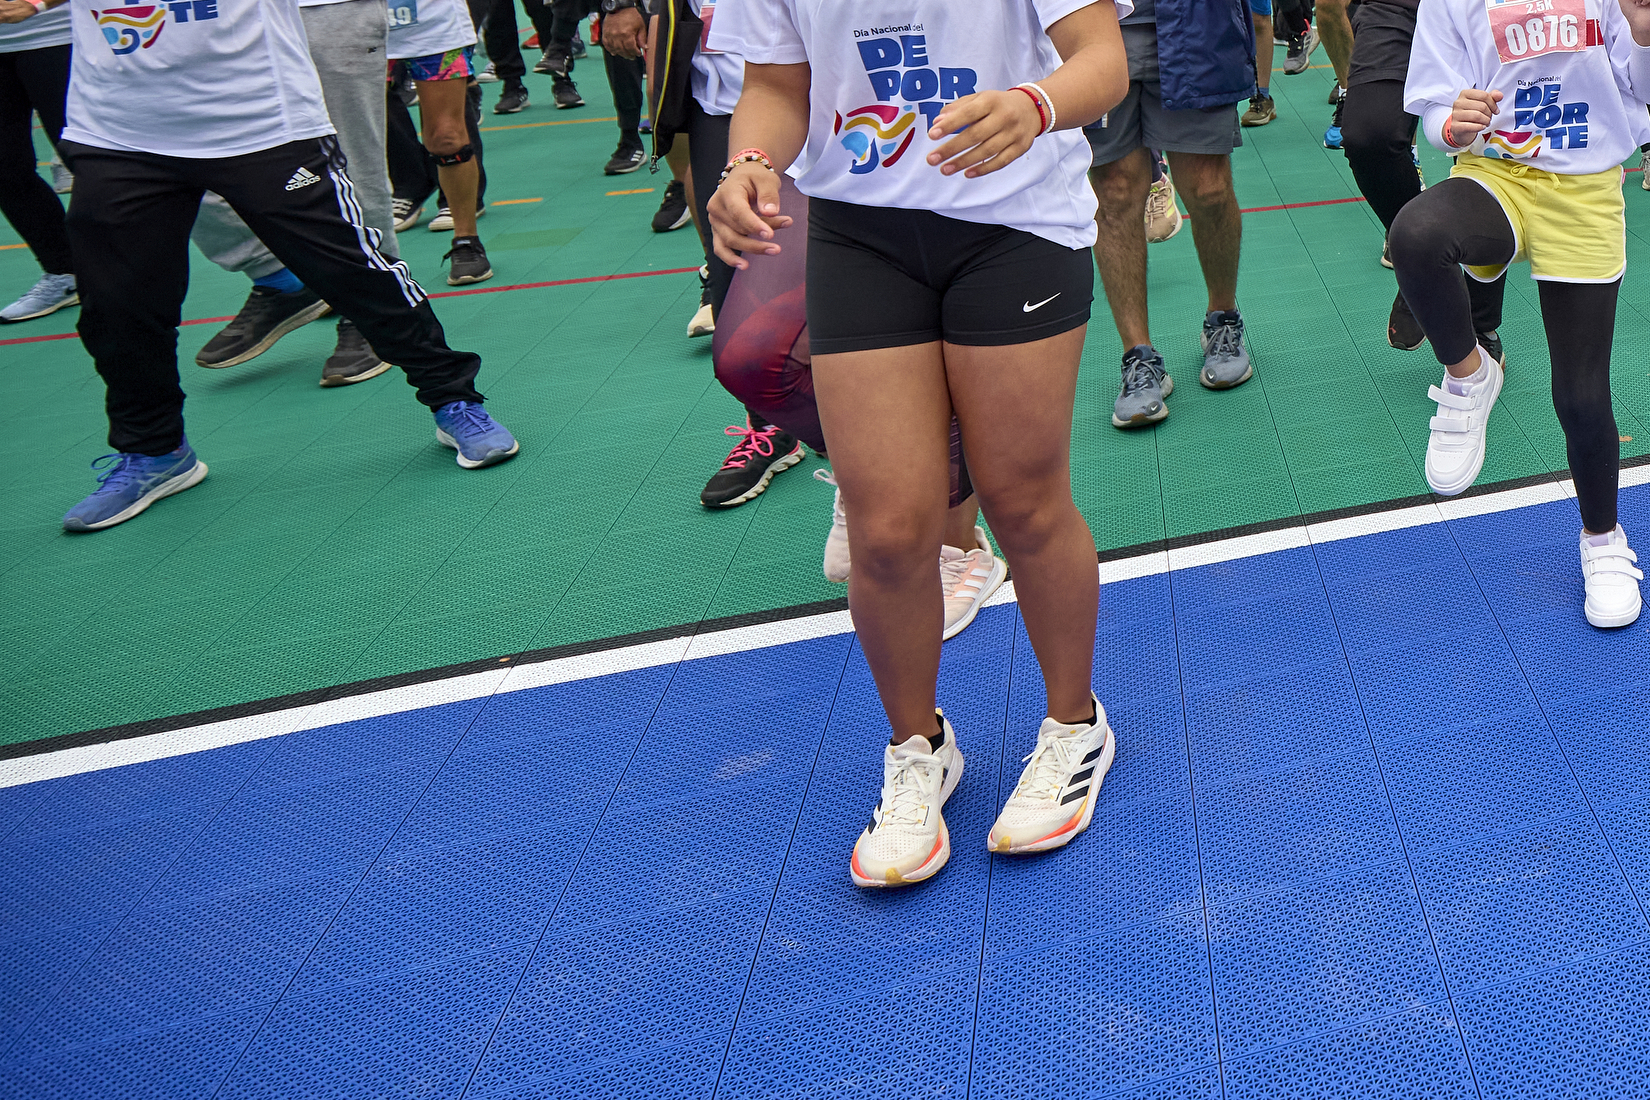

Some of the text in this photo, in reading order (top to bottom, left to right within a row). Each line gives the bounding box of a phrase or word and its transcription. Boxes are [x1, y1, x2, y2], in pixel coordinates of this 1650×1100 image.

[853, 29, 869, 38] Día
[870, 23, 912, 36] Nacional
[1504, 14, 1578, 57] 0876
[856, 34, 929, 72] DE
[867, 66, 978, 102] POR
[1514, 83, 1562, 109] DE
[1513, 101, 1590, 131] POR
[1545, 125, 1590, 150] TE
[284, 175, 322, 191] adidas
